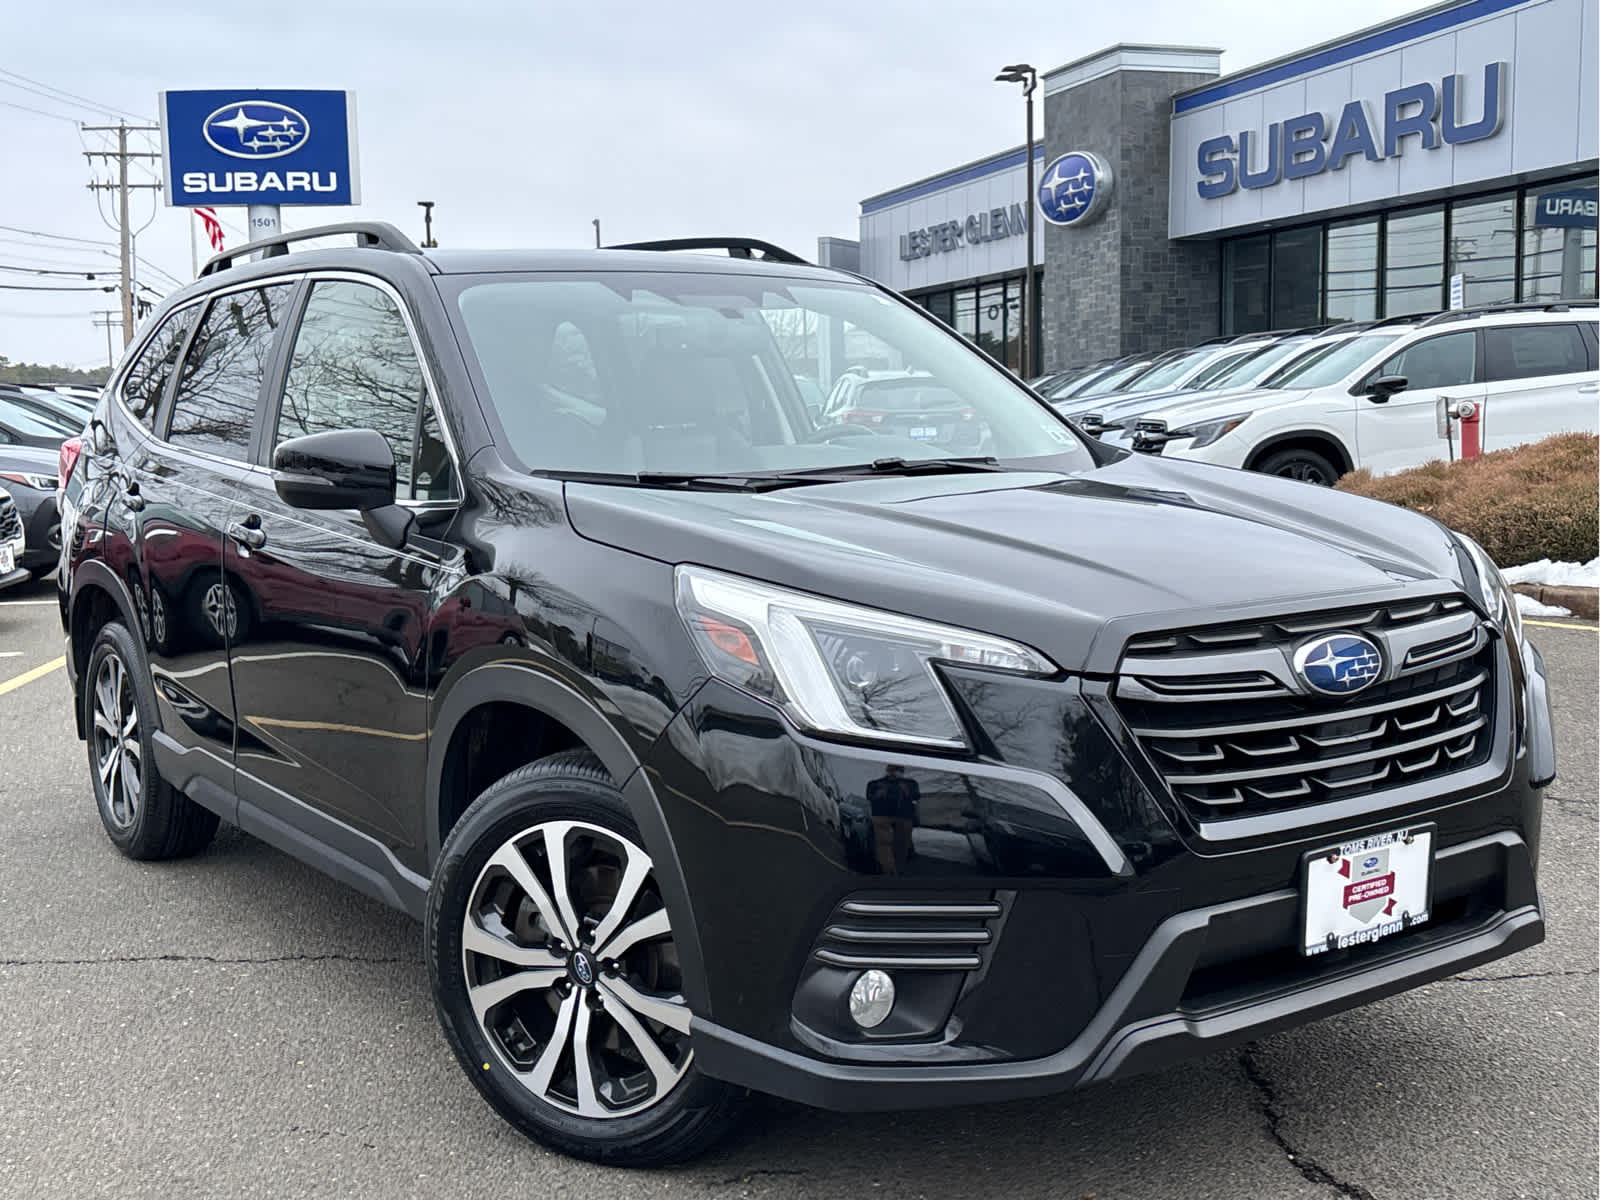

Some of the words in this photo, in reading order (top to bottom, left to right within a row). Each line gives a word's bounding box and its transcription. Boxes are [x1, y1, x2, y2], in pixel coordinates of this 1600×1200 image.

[1197, 61, 1505, 199] SUBARU
[183, 171, 337, 193] SUBARU
[252, 218, 277, 228] 1501
[899, 220, 964, 261] LESTER
[1348, 886, 1390, 903] PRE-OWNED
[1352, 878, 1387, 894] CERTIFIED
